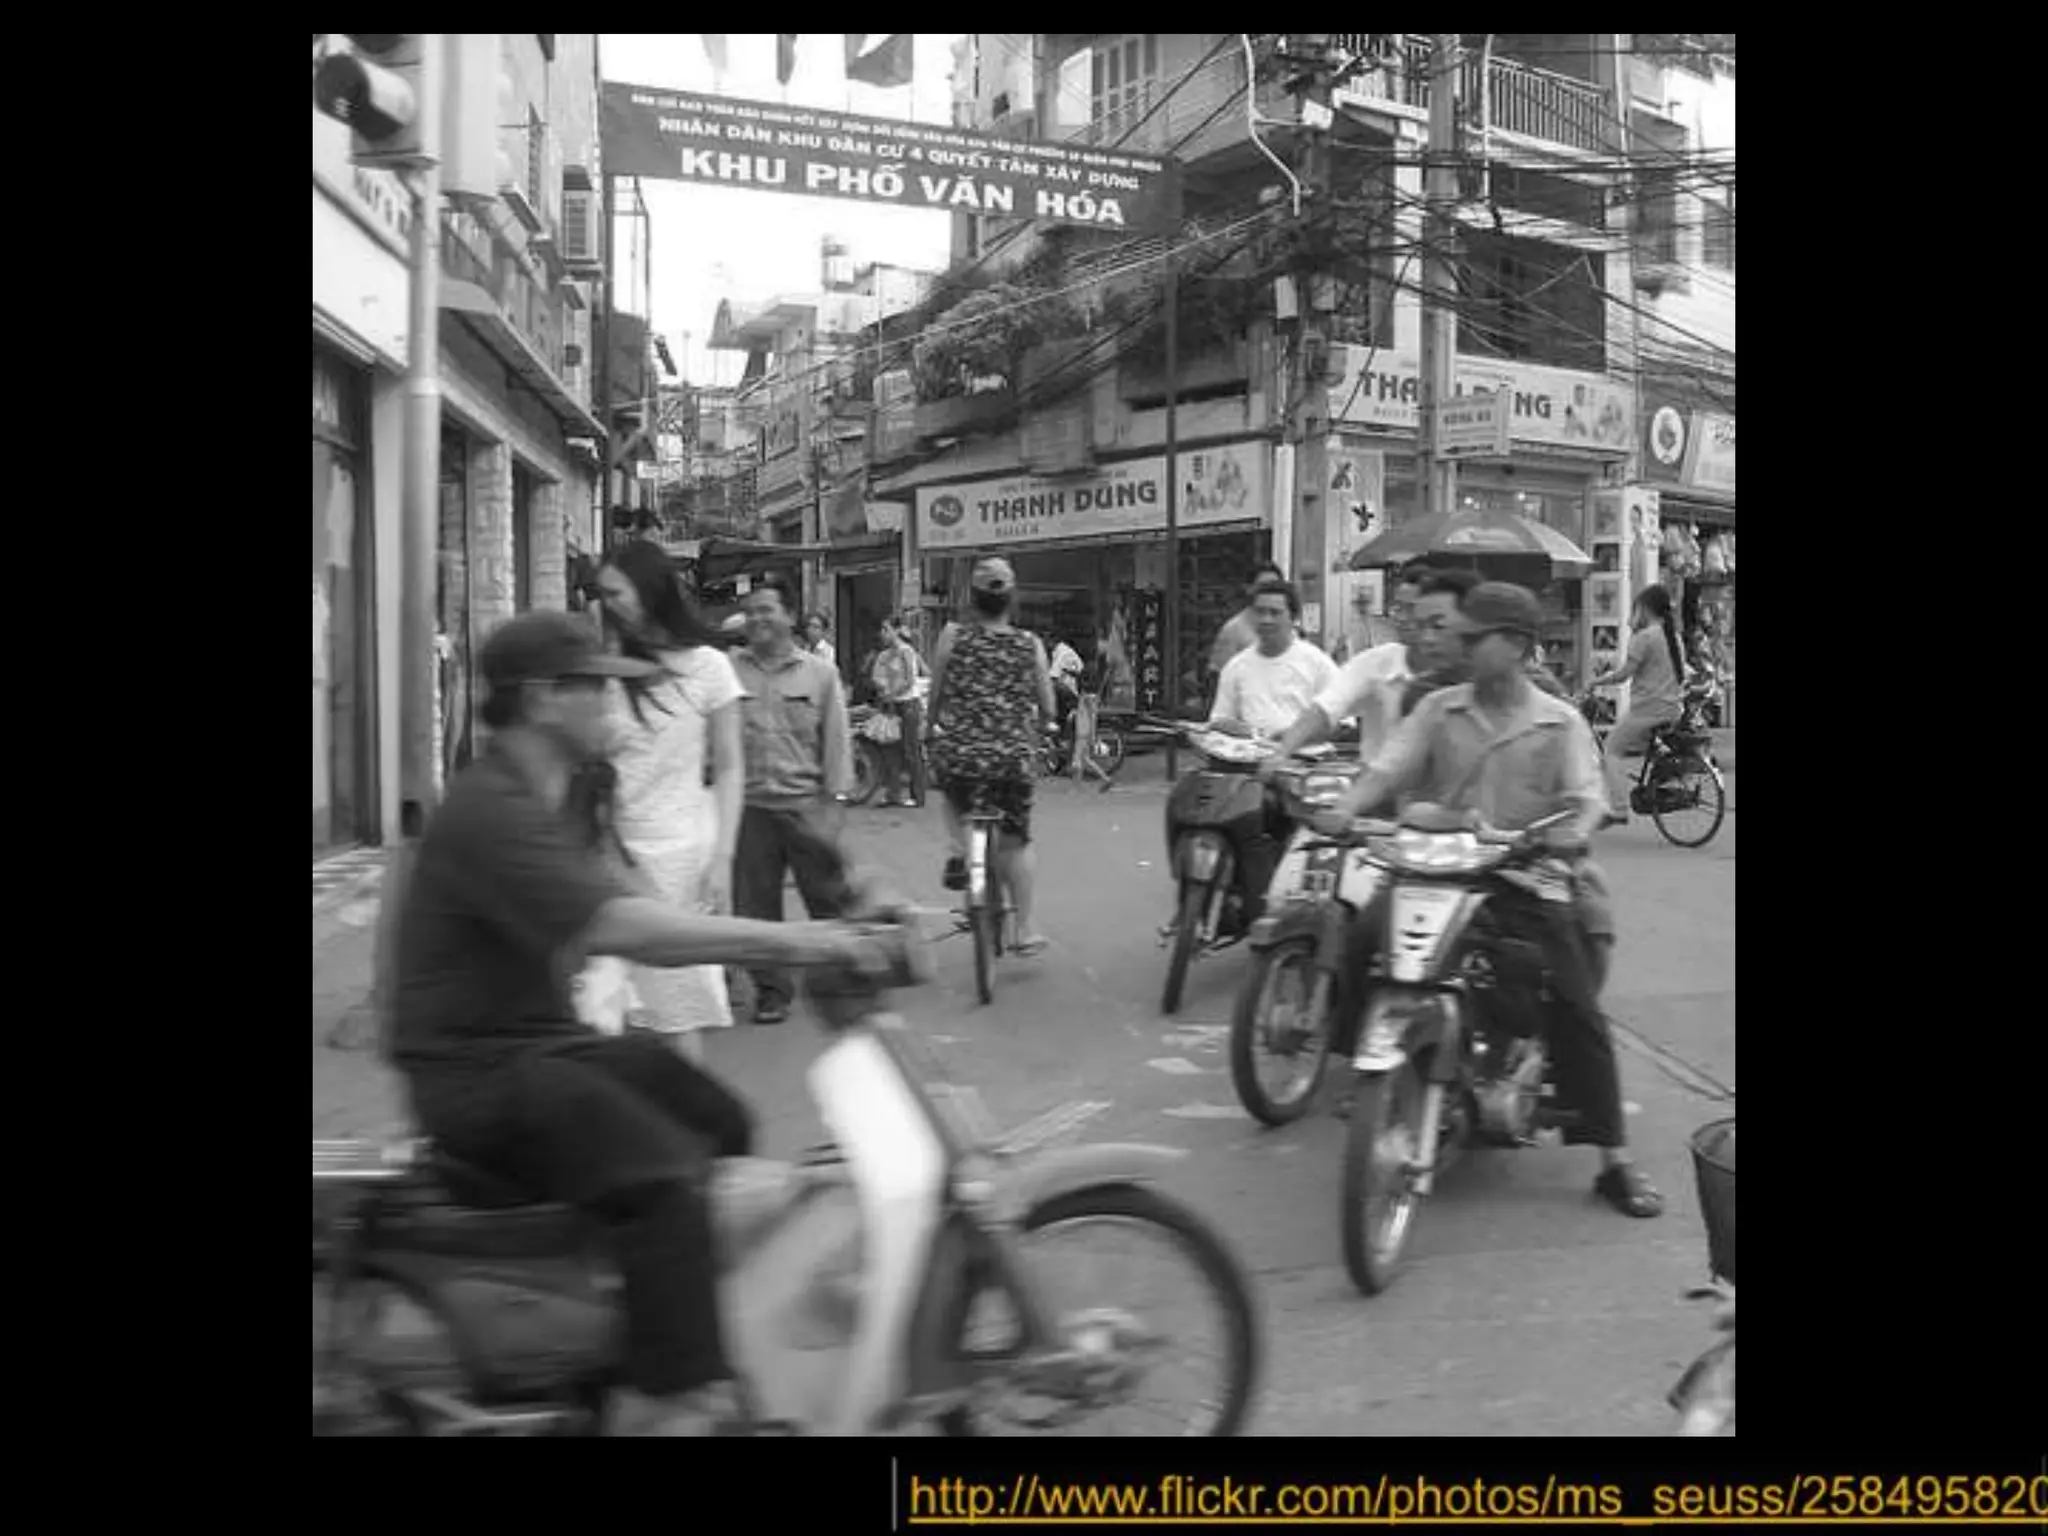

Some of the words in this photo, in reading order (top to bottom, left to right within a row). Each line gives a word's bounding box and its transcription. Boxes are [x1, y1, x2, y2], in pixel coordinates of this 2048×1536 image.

[681, 146, 786, 184] KHU
[806, 161, 906, 197] PHỐ
[919, 172, 1014, 212] VĂN
[1036, 189, 1126, 225] HÓA
[977, 490, 1066, 524] THANH
